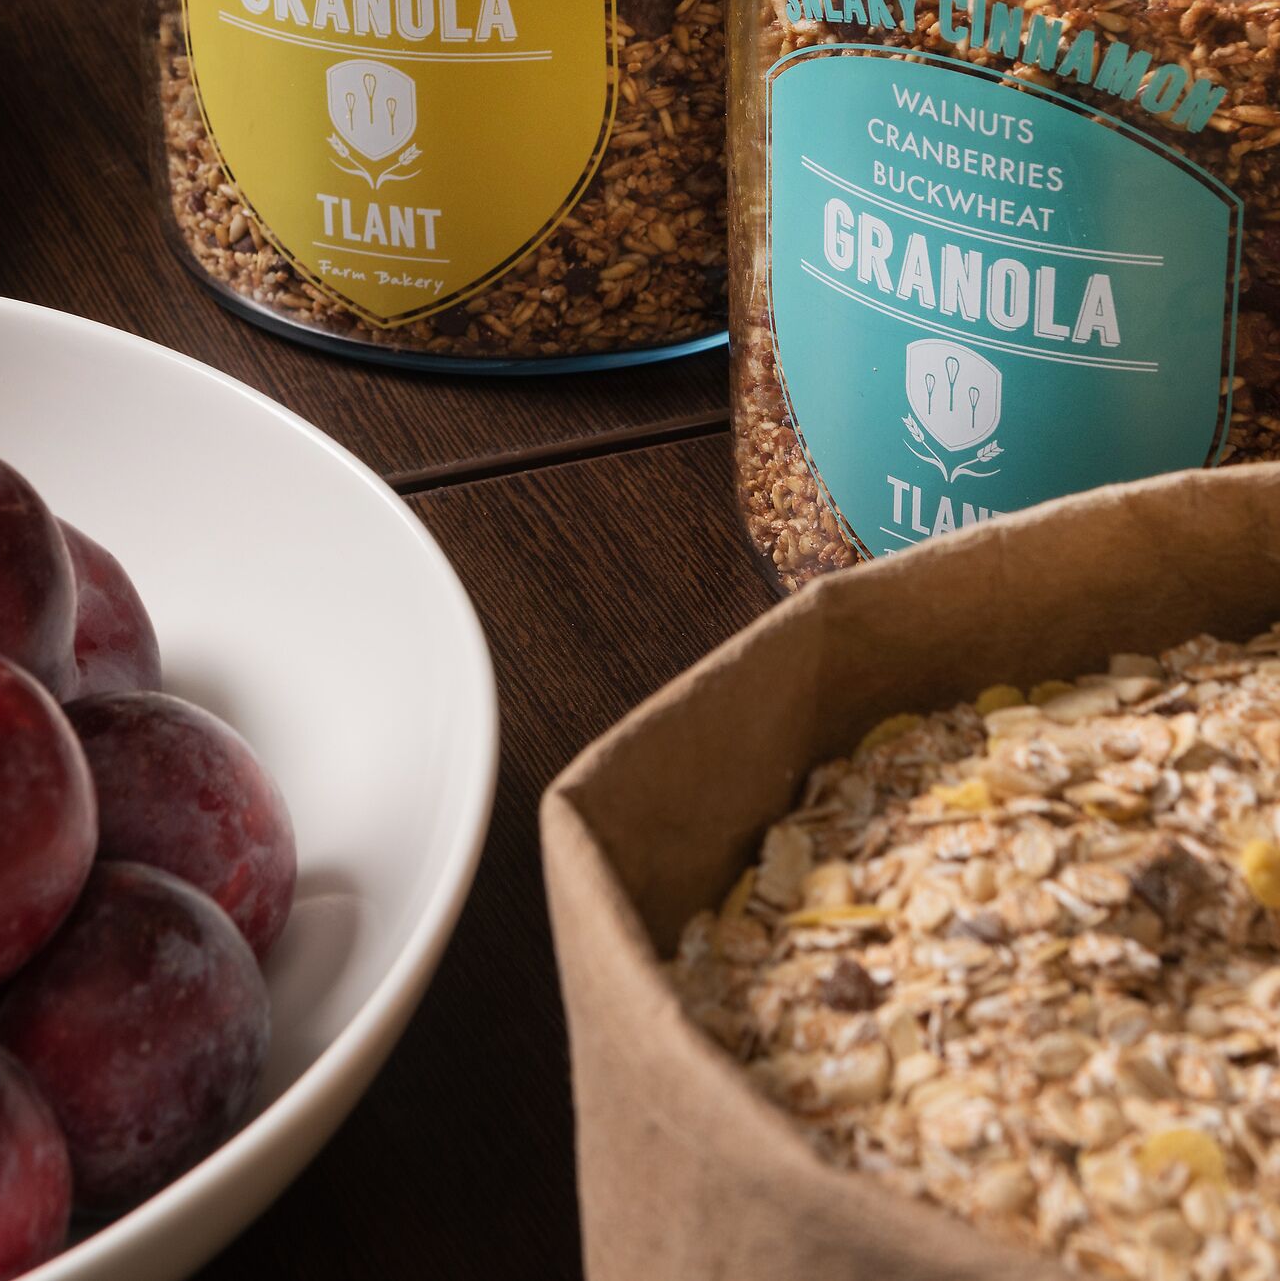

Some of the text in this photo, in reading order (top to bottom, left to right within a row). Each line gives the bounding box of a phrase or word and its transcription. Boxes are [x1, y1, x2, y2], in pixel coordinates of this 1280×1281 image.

[891, 82, 1035, 145] WALNUTS
[867, 117, 1064, 194] CRANBERRIES
[316, 192, 442, 251] TLANT
[872, 159, 1056, 233] BUCKWHEAT
[317, 258, 445, 296] Farm Bakery
[823, 197, 1122, 348] GRANOLA
